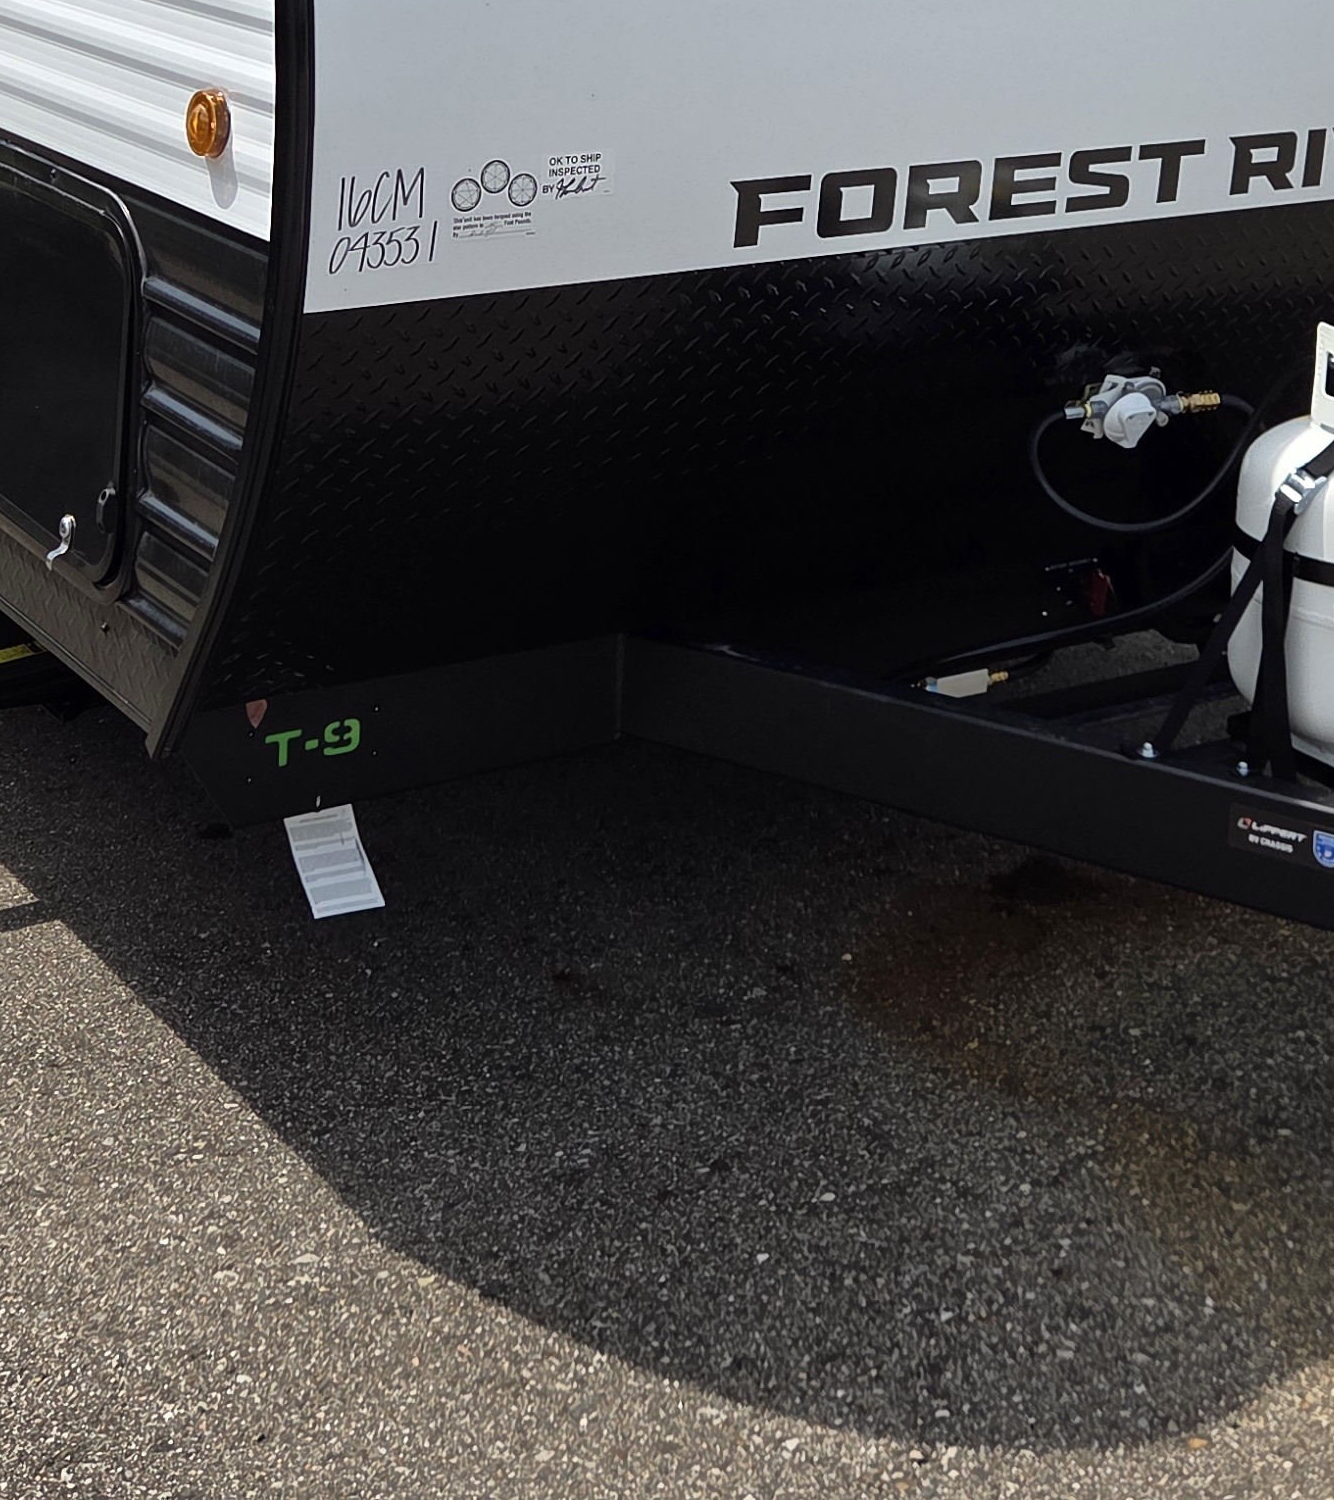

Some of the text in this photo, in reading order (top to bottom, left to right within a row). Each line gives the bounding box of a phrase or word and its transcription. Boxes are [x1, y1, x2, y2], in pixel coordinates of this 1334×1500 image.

[549, 153, 602, 166] OK TO SHIP
[549, 164, 601, 178] INSPECTED
[337, 166, 425, 232] 16CM
[542, 184, 555, 194] BY
[729, 138, 1207, 249] FOREST
[265, 718, 360, 767] T-9
